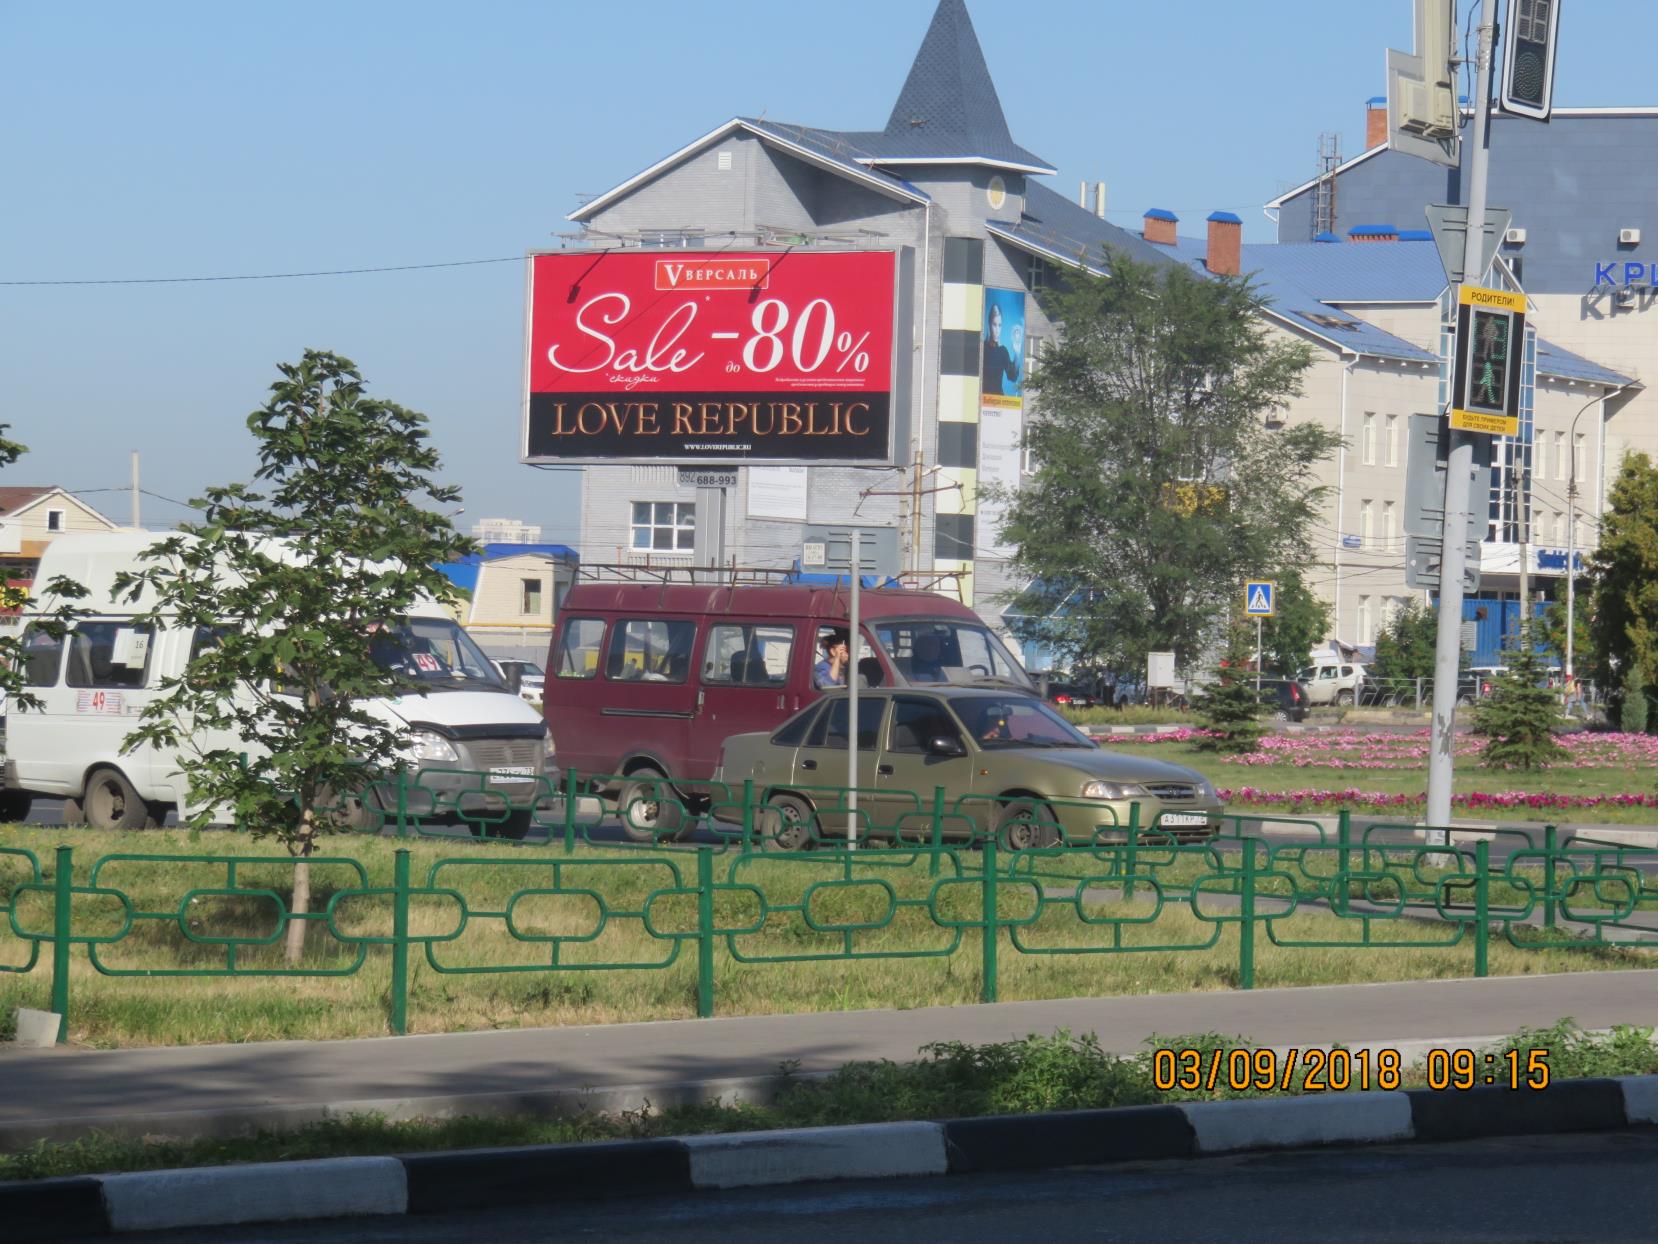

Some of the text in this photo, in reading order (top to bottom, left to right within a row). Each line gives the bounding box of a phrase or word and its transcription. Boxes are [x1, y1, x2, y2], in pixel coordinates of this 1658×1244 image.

[1471, 291, 1515, 306] РОДИТЕЛИ!
[725, 360, 741, 373] до
[552, 402, 871, 436] LOVE REPUBLIC
[697, 476, 736, 485] 688-993
[415, 654, 438, 671] 49
[92, 691, 105, 711] 49
